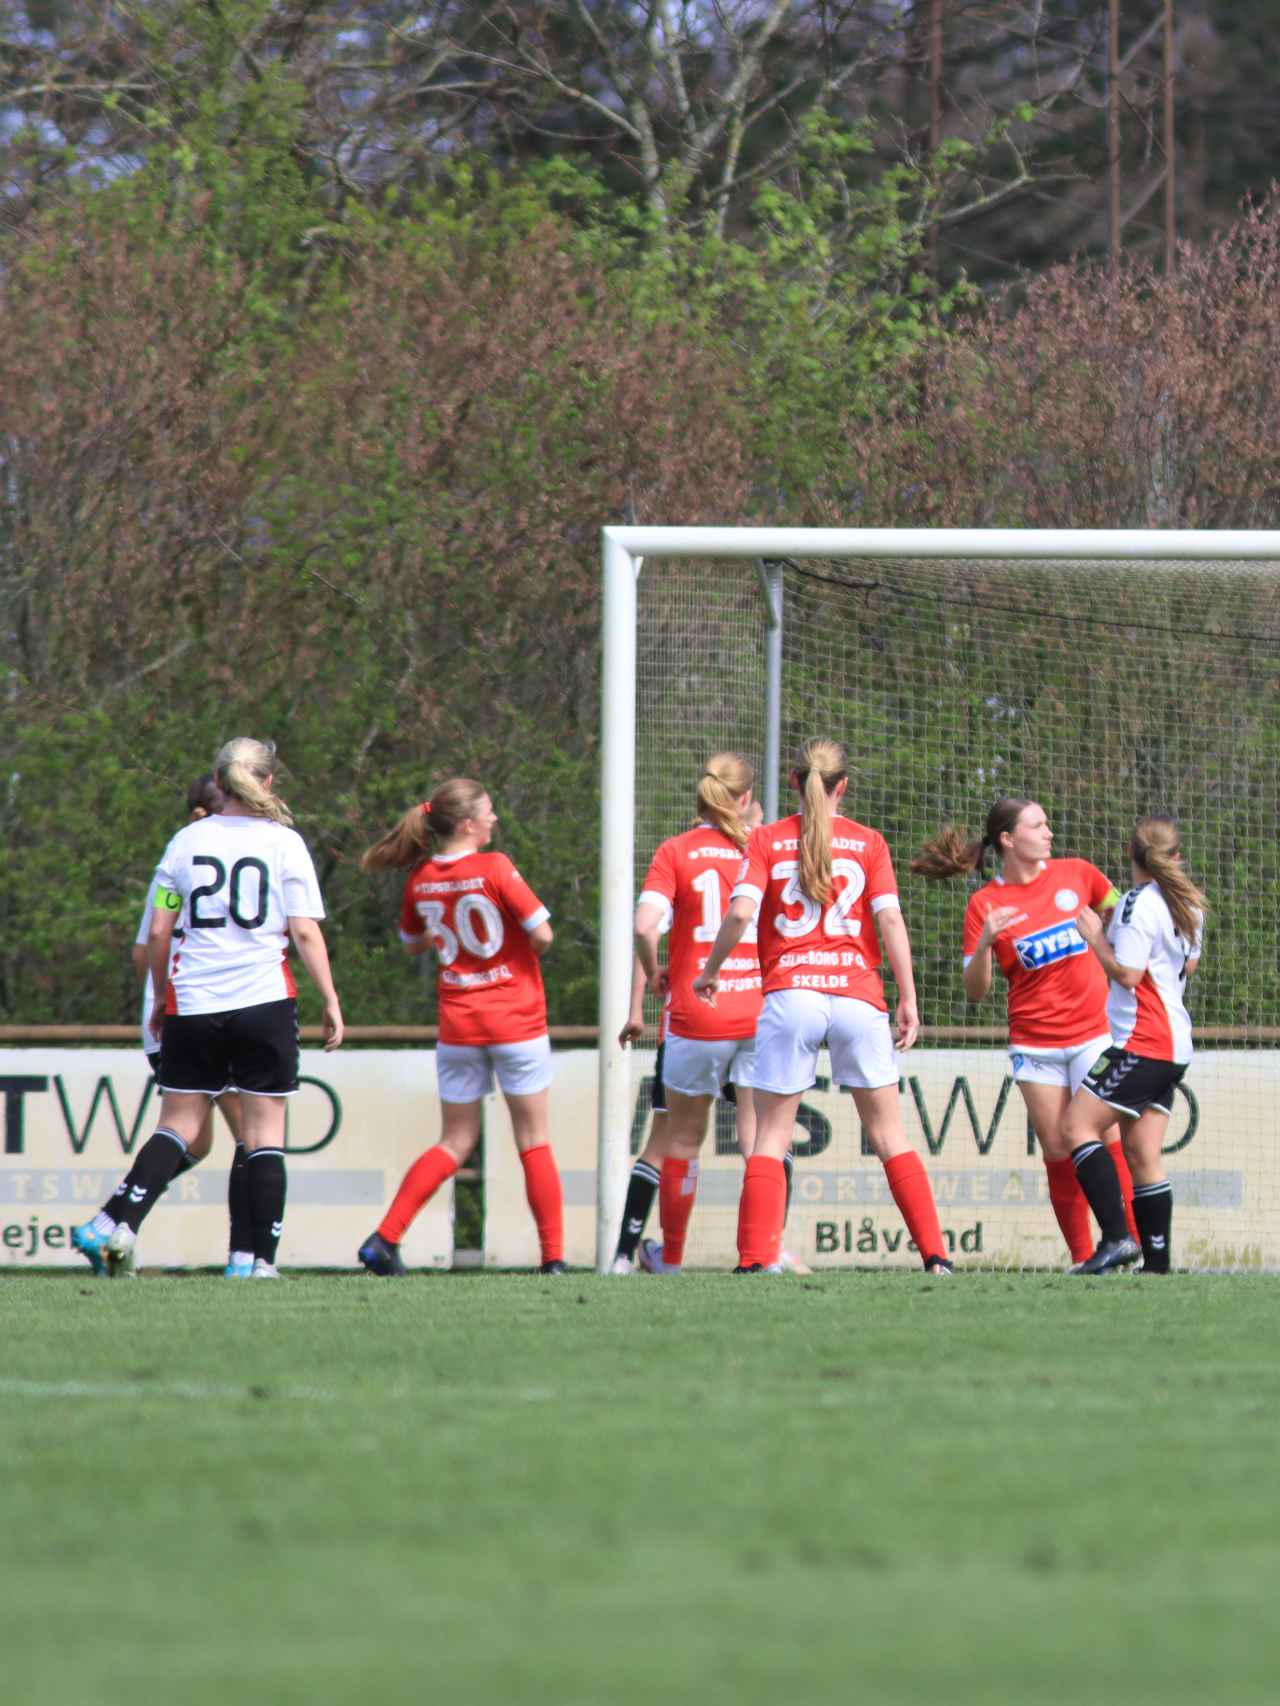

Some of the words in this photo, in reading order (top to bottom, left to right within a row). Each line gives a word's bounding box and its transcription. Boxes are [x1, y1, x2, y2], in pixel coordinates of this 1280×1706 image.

[190, 855, 269, 929] 20
[771, 857, 867, 938] 32
[416, 893, 505, 966] 30
